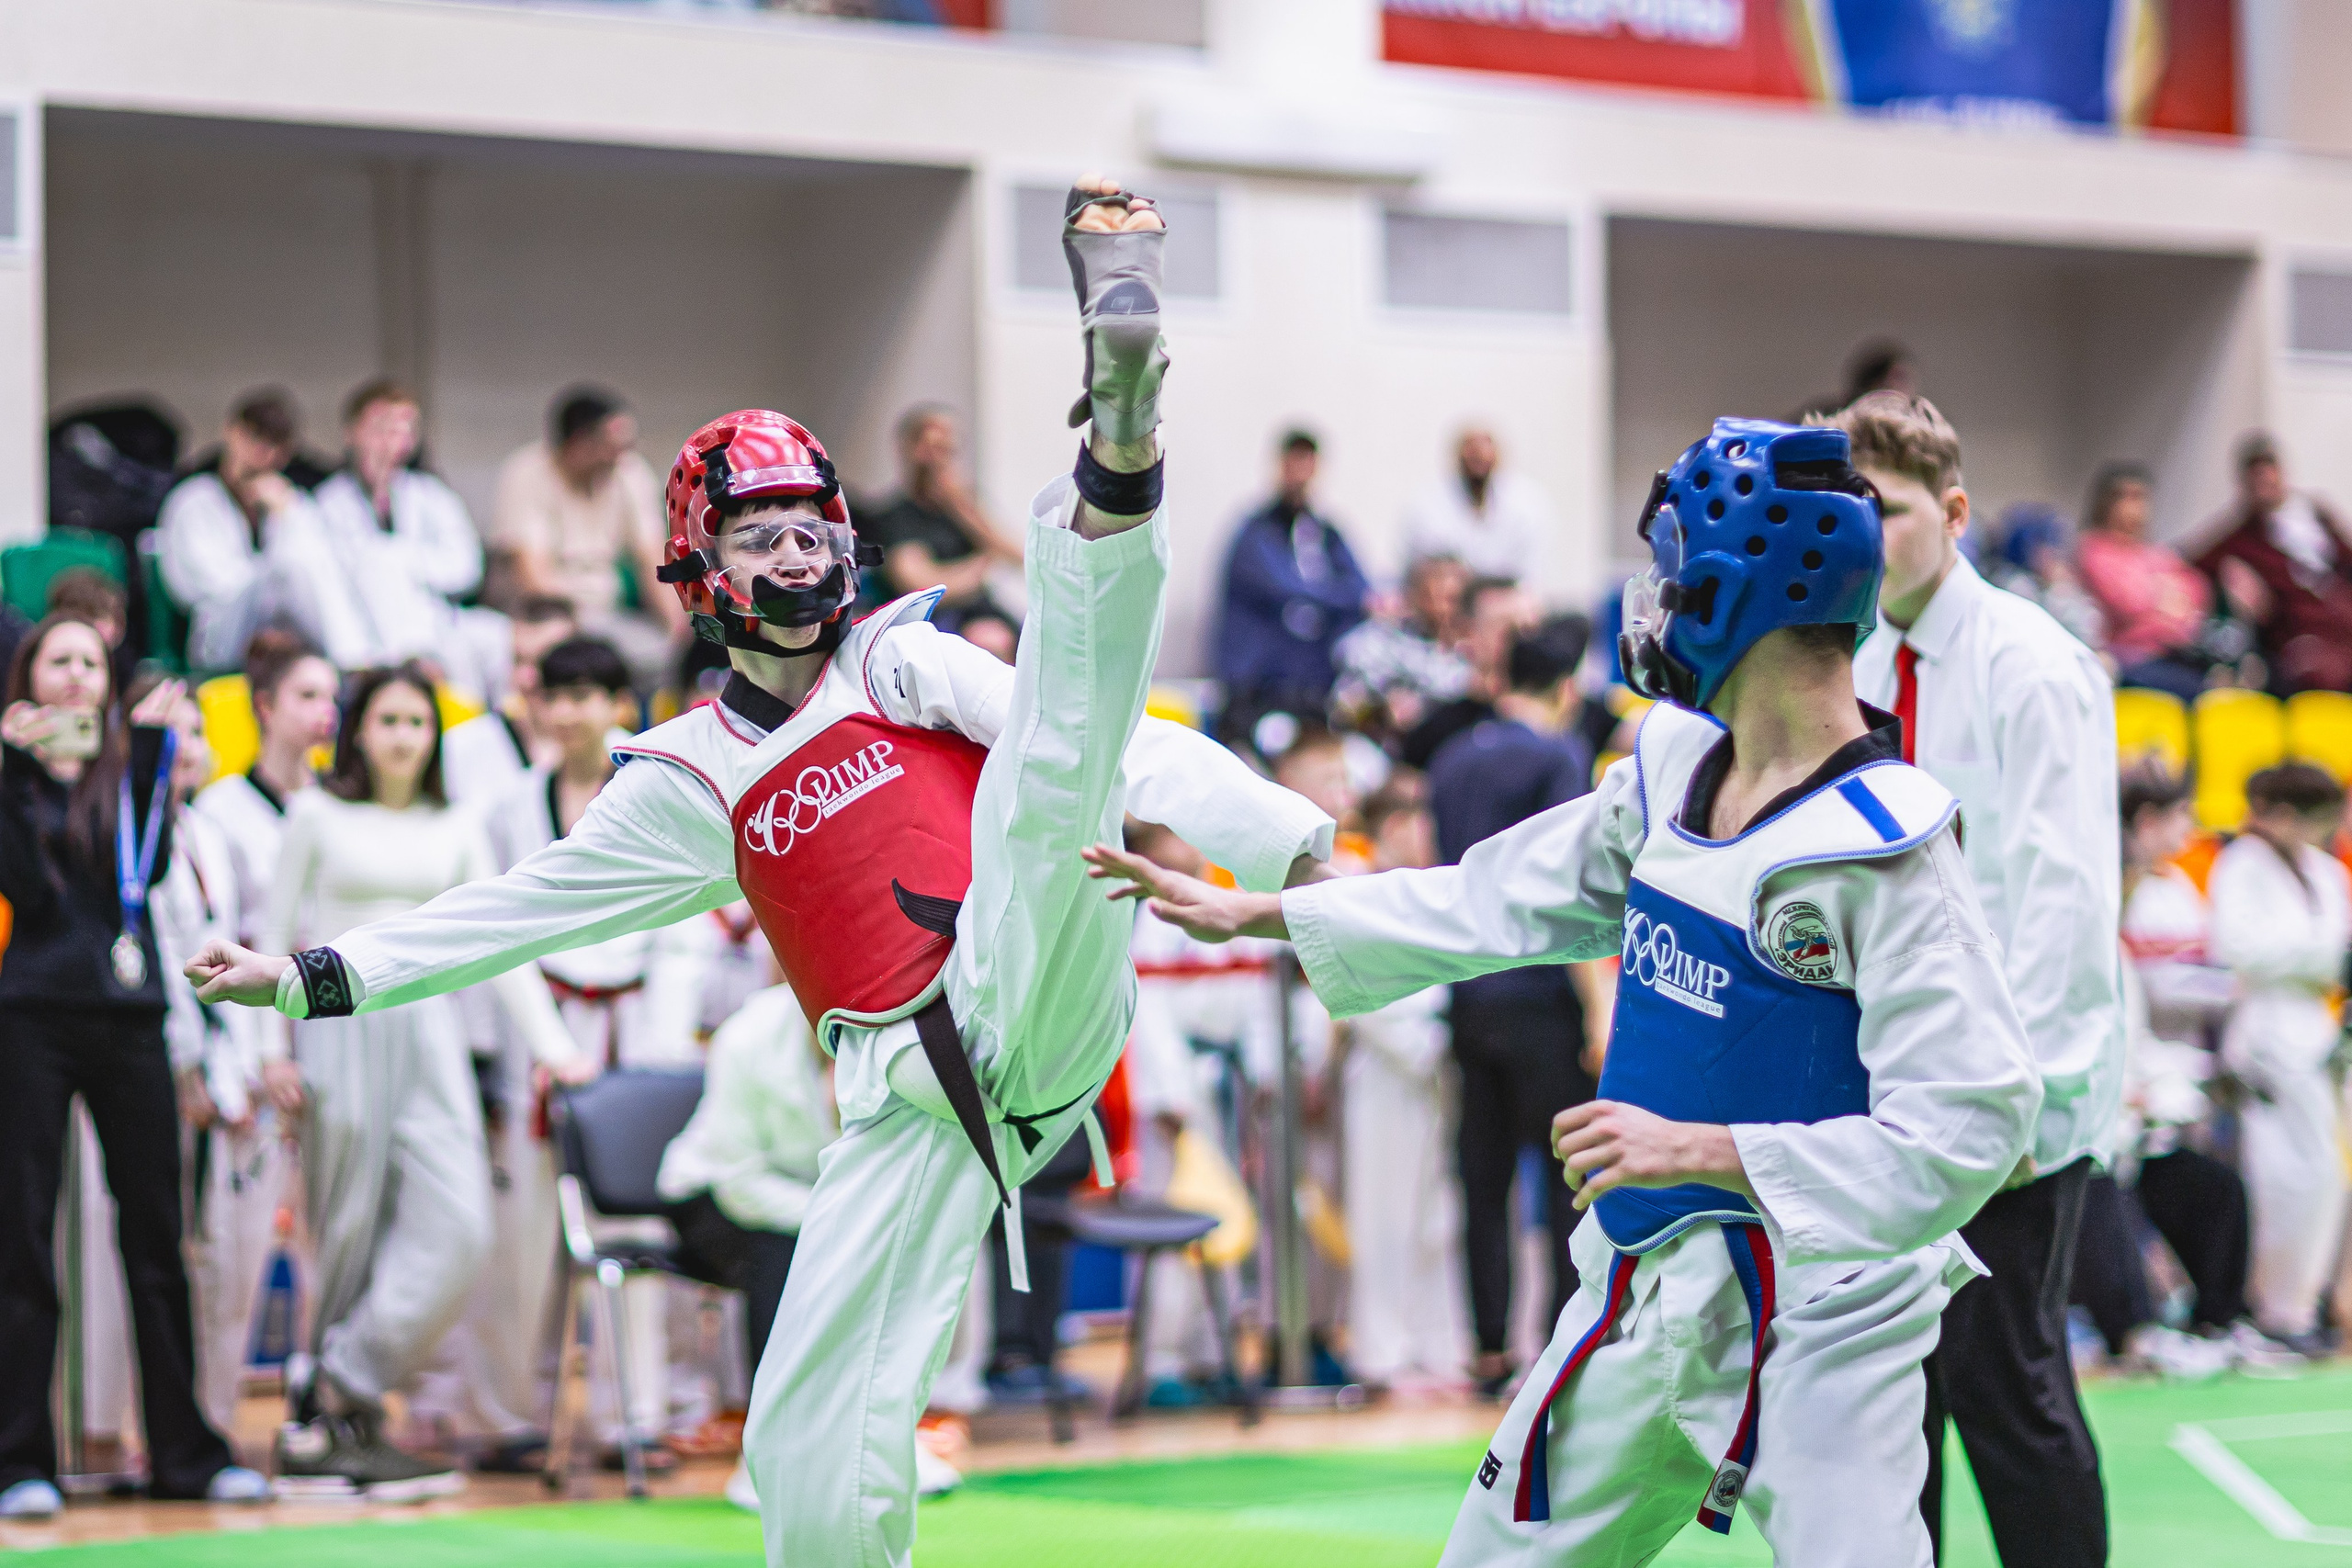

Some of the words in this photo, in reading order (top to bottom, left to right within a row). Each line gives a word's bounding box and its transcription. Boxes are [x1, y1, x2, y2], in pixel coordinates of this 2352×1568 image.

[796, 739, 894, 807] OLIMP
[824, 784, 869, 815] taekwondo
[871, 767, 901, 784] league
[1652, 923, 1730, 1000] OLIMP
[1656, 981, 1691, 1002] taekwondo
[1693, 997, 1721, 1013] league
